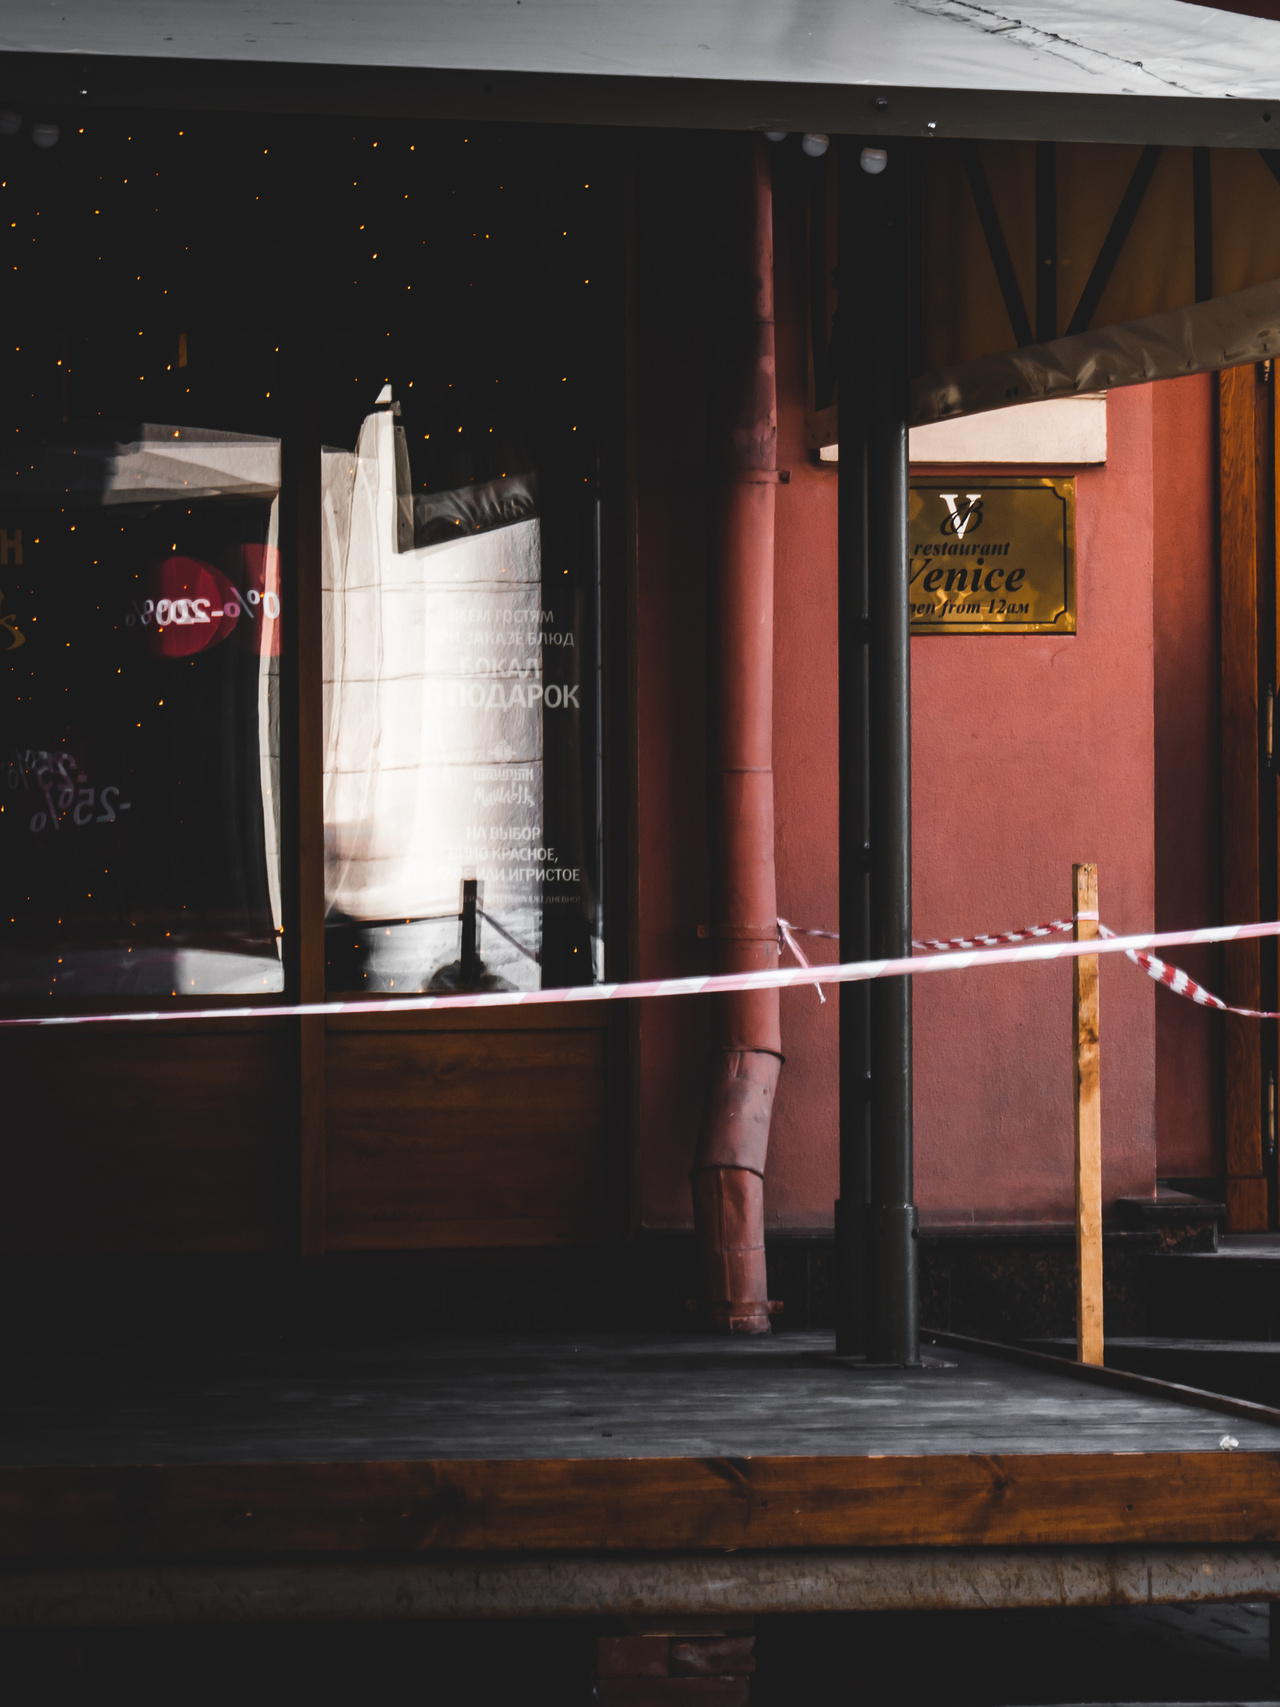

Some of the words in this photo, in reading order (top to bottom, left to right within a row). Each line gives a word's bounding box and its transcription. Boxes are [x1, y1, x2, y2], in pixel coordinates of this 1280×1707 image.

[913, 541, 1011, 556] restaurant
[496, 609, 554, 623] ГОСТЯМ
[939, 599, 981, 618] from
[527, 632, 575, 647] БЛЮД
[460, 657, 540, 679] БОКАЛ
[449, 684, 580, 712] ПОДАРОК
[466, 827, 487, 840] НА
[490, 827, 541, 840] ВЫБОР
[492, 848, 559, 863] КРАСНОЕ,
[477, 869, 504, 882] ИЛИ
[509, 868, 581, 882] ИГРИСТОЕ
